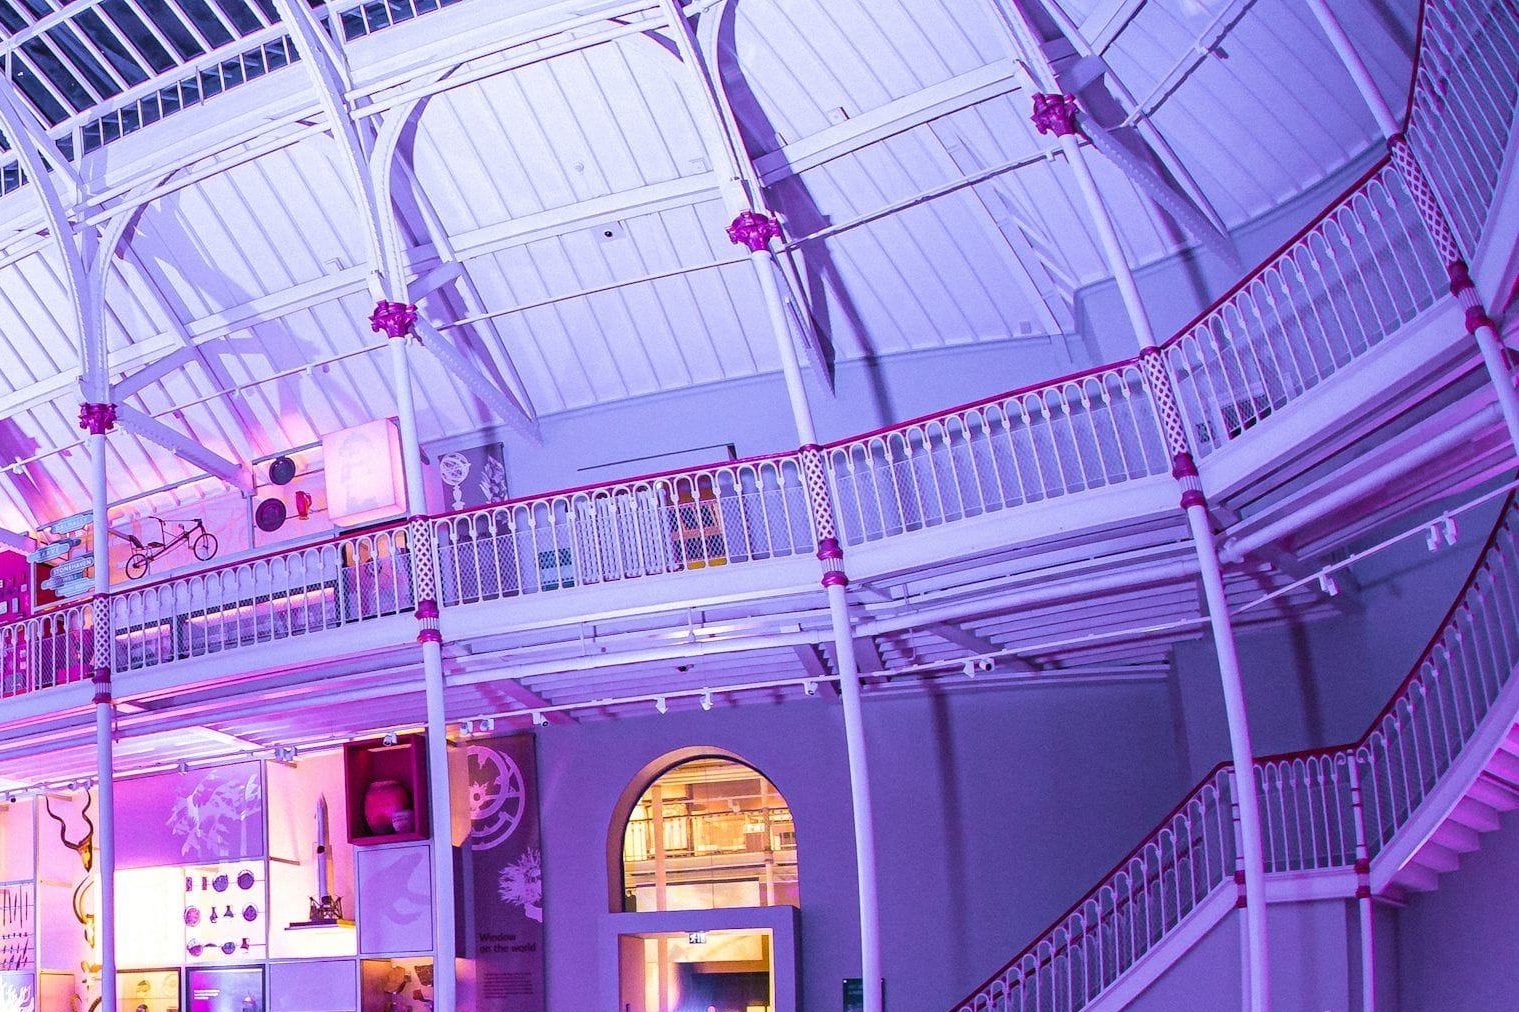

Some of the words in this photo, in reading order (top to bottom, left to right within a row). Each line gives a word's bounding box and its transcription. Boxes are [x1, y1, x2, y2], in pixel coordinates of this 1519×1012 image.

[53, 558, 93, 575] STONEHAVEN
[479, 933, 516, 942] Window
[494, 944, 509, 953] the
[512, 943, 536, 953] world
